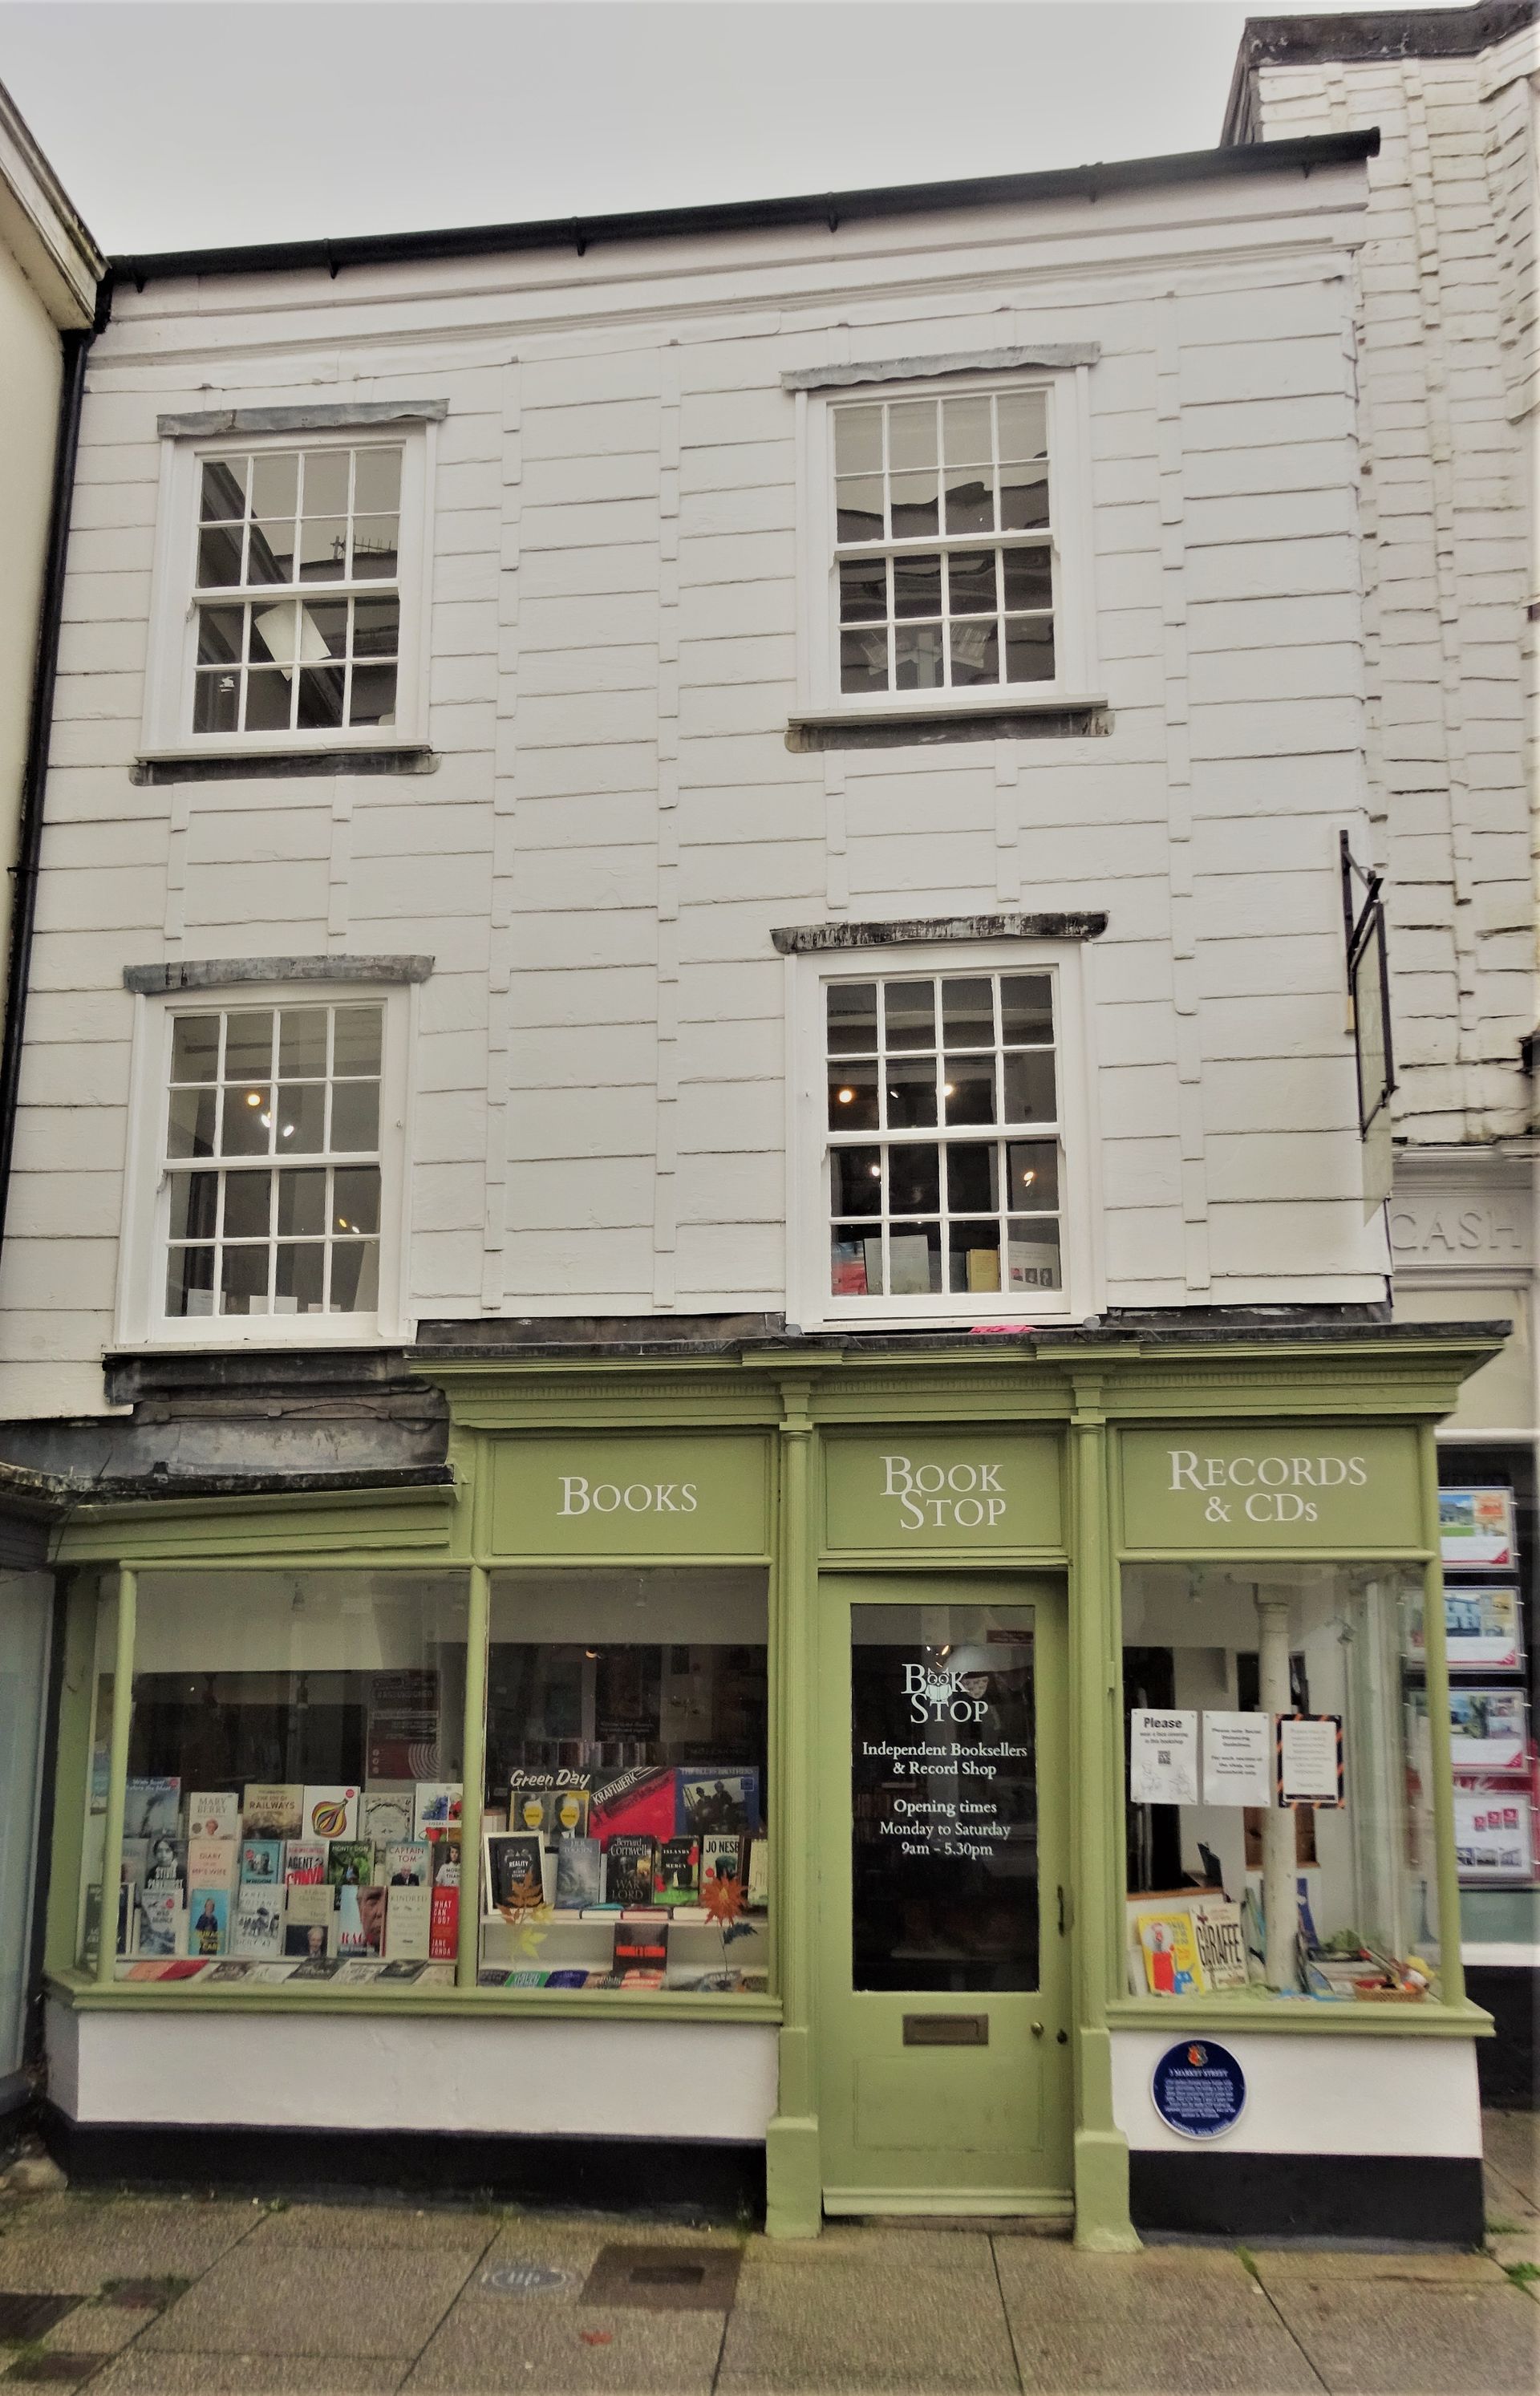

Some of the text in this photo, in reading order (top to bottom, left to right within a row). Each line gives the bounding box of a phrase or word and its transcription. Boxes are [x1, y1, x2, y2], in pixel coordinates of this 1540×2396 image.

[1391, 1211, 1522, 1250] CASH
[880, 1456, 1006, 1495] BOOK
[1167, 1450, 1368, 1490] RECORDS
[557, 1477, 698, 1515] BOOKS
[900, 1487, 1006, 1530] STOP
[1205, 1496, 1231, 1522] &
[910, 1693, 989, 1724] STOP
[1143, 1717, 1182, 1728] Please
[862, 1741, 1027, 1760] Independent Booksellers
[510, 1769, 591, 1790] Green Day
[893, 1762, 997, 1779] & Record Shop
[593, 1773, 638, 1806] KRAFTWERK
[249, 1802, 295, 1810] RAILWAYS
[894, 1799, 997, 1817] Opening times
[880, 1822, 1011, 1840] Monday to Saturday
[610, 1844, 647, 1856] Cornwell
[706, 1841, 717, 1853] JO
[902, 1843, 930, 1855] 9am
[944, 1843, 994, 1860] 5.30pm
[289, 1856, 312, 1869] AGENT
[616, 1879, 641, 1889] WAR
[435, 1900, 452, 1908] WHAT
[611, 1890, 643, 1900] LORD
[432, 1948, 451, 1956] FONDA
